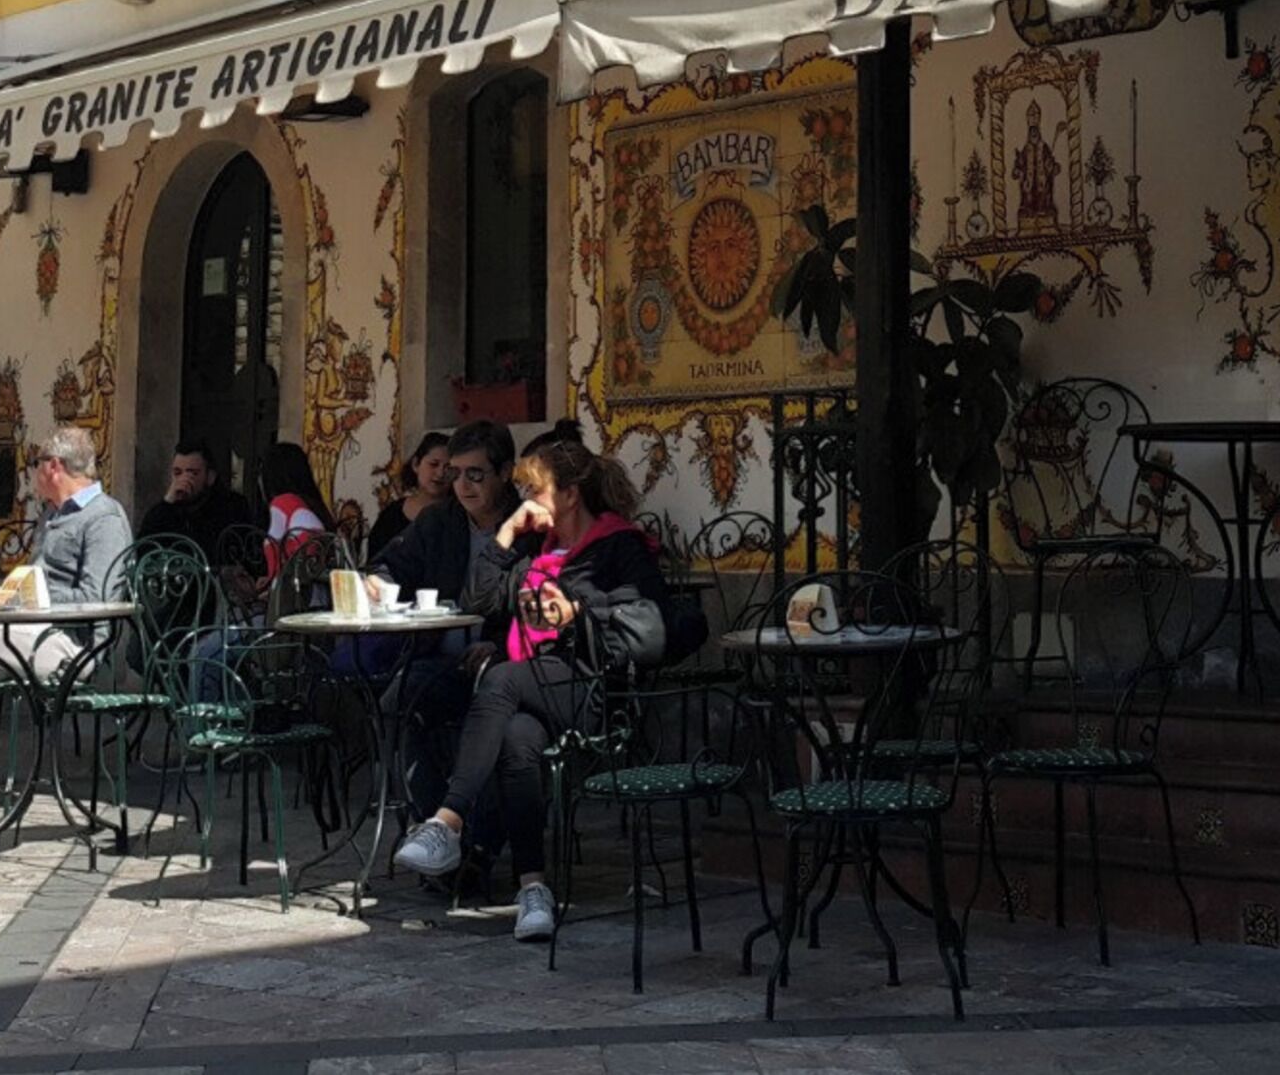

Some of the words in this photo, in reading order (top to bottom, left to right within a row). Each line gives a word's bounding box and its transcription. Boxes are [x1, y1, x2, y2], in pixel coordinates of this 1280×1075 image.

[41, 66, 198, 137] GRANITE
[677, 132, 770, 182] BAMBAR
[689, 359, 765, 379] TAORMINA
